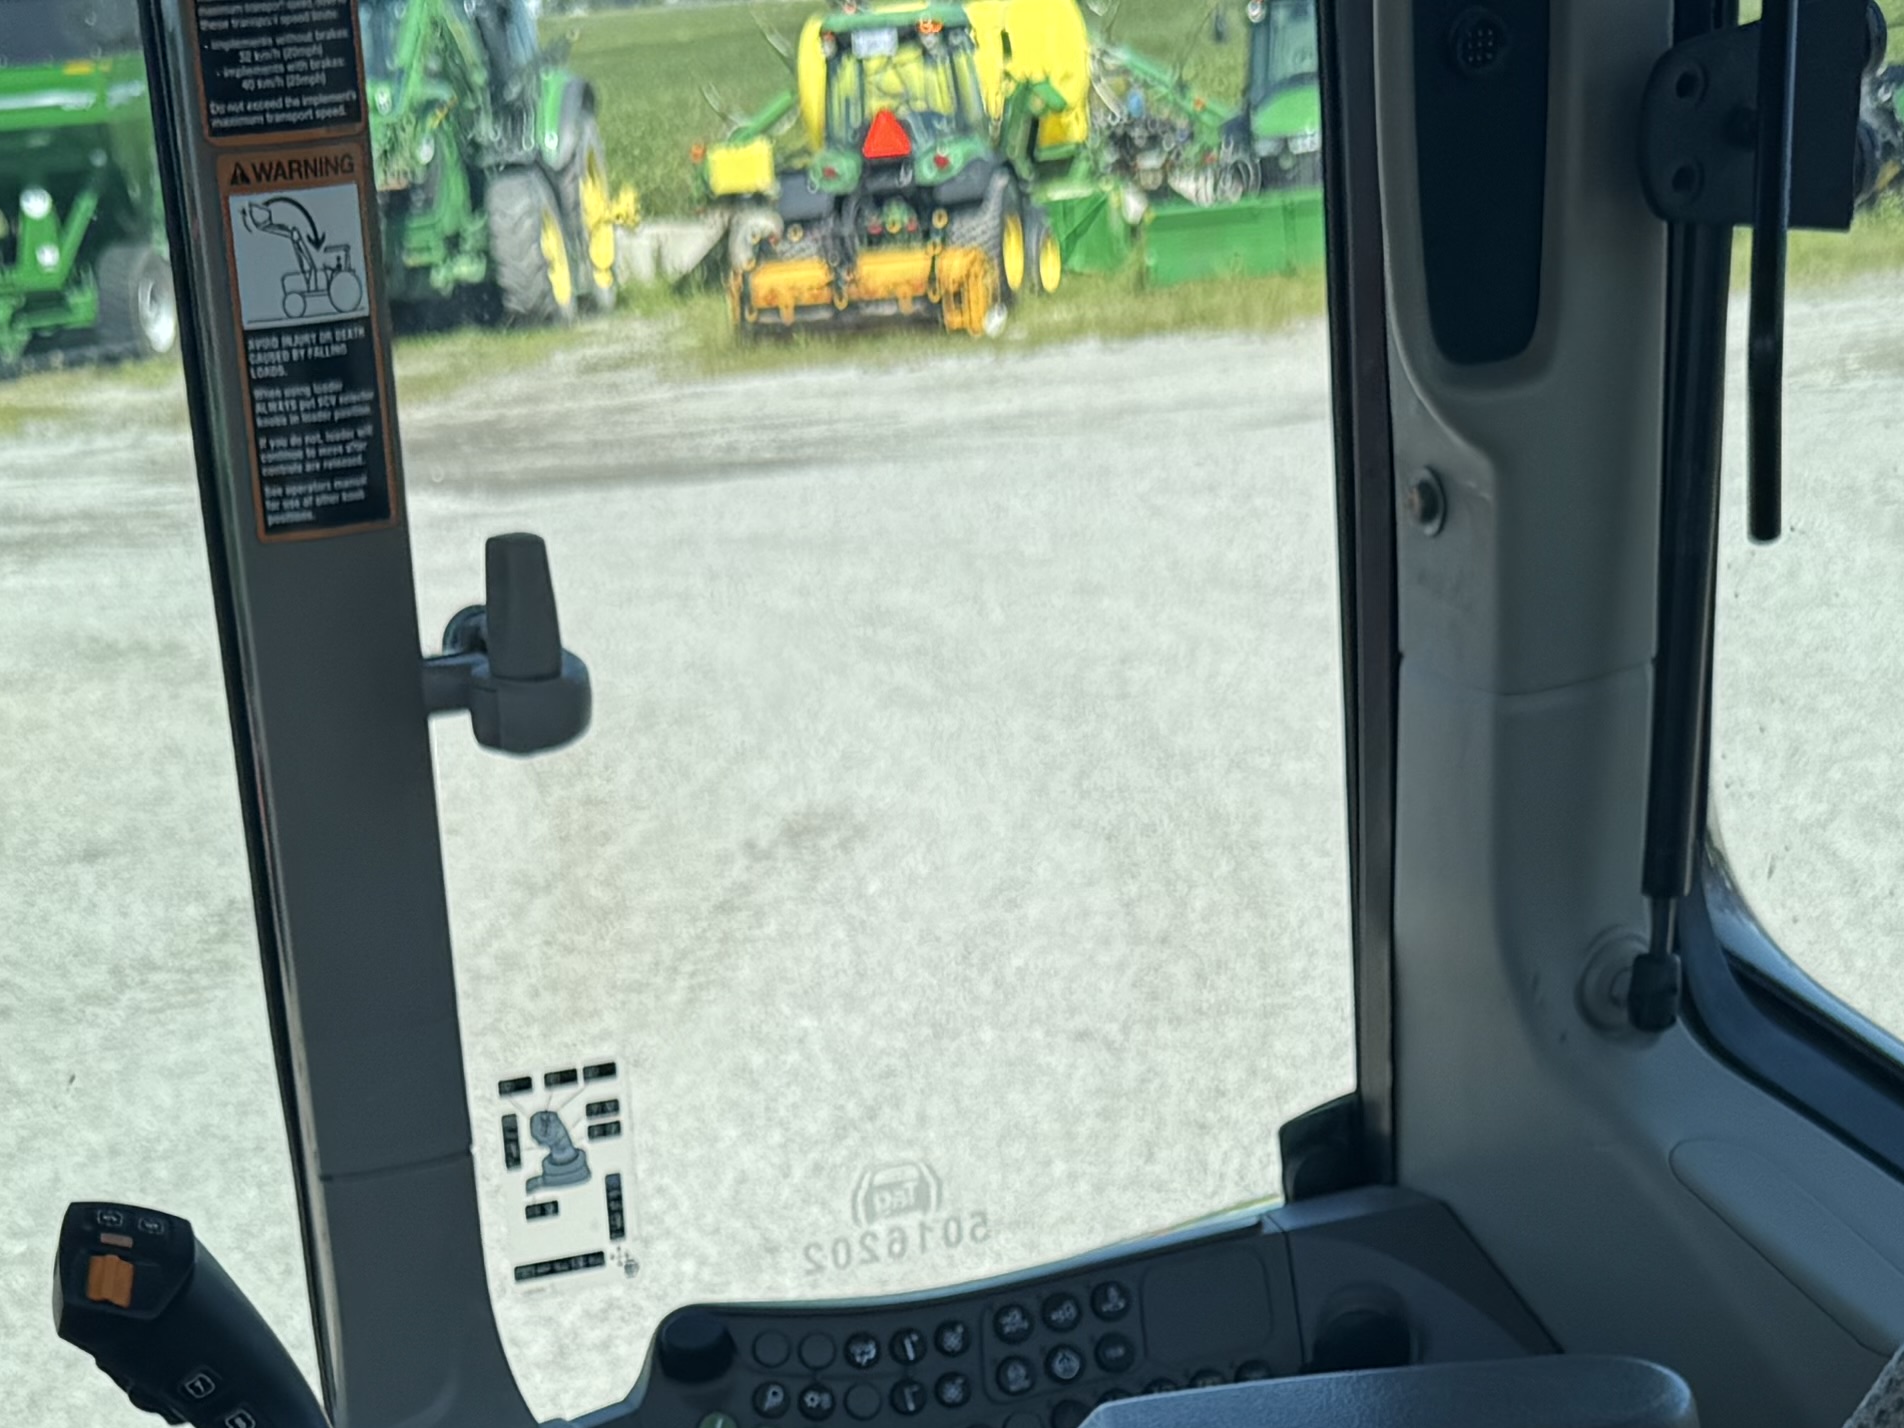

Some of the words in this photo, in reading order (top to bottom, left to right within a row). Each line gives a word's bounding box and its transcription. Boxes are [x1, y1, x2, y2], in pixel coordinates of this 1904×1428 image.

[253, 50, 281, 62] km/h
[286, 60, 309, 72] with
[257, 76, 285, 89] km/h
[226, 100, 244, 113] not
[246, 97, 283, 111] exceed
[284, 96, 301, 108] the
[265, 109, 314, 124] transport
[251, 153, 355, 182] WARNING
[280, 333, 316, 347] INJURY
[318, 330, 333, 344] OR
[335, 325, 365, 341] DEATH
[292, 348, 305, 361] BY
[255, 398, 298, 415] ALWAYS
